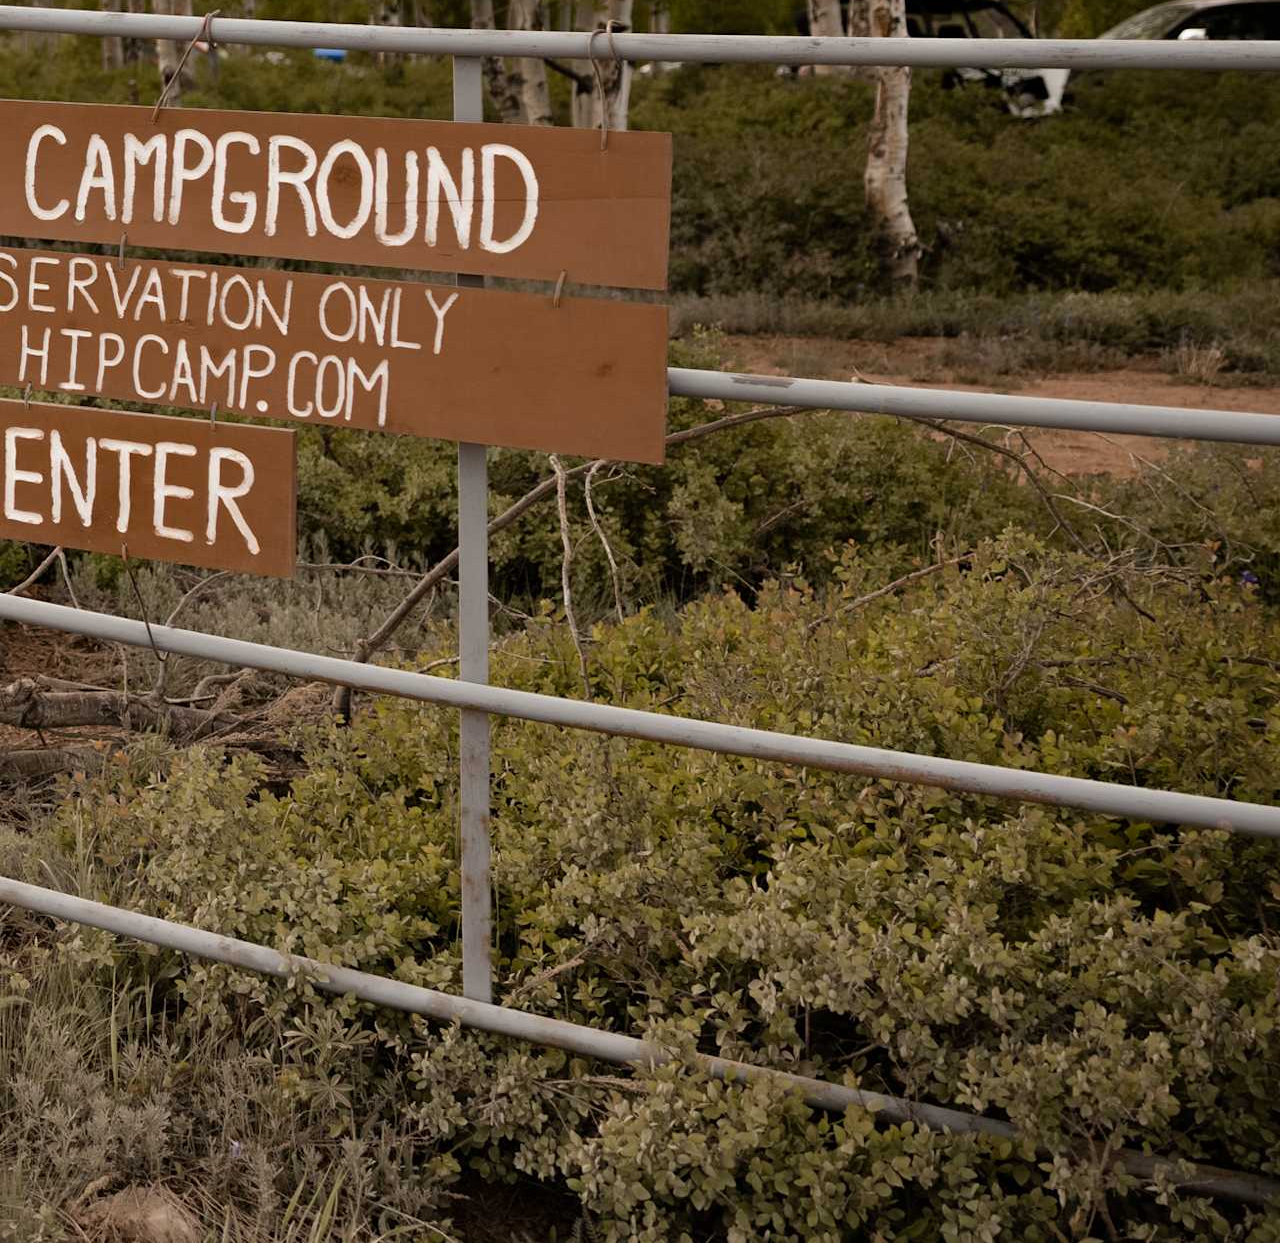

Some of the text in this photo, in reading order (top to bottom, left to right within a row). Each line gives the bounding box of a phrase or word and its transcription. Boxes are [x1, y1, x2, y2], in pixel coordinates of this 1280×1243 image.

[24, 124, 539, 254] CAMPGROUND
[18, 324, 390, 427] HIPCAMP.COM
[319, 281, 459, 354] ONLY
[4, 426, 261, 555] ENTER
